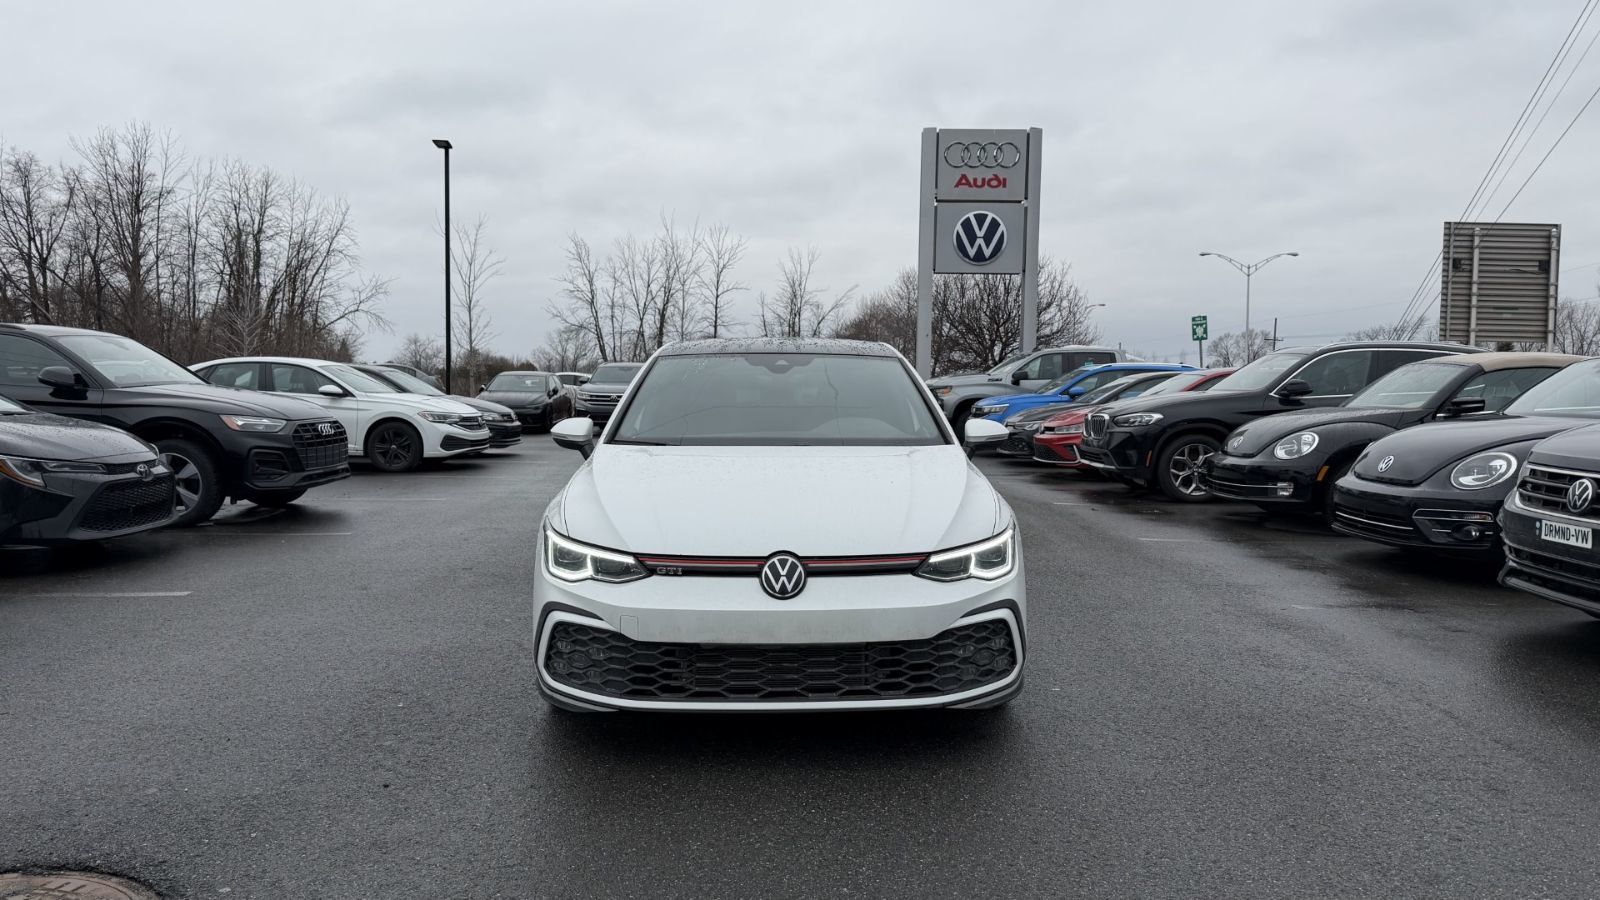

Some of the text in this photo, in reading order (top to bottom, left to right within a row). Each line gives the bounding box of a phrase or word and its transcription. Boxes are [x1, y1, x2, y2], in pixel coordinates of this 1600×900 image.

[954, 174, 1007, 188] Audi
[954, 211, 1006, 264] VW
[1567, 479, 1592, 512] VW
[1544, 522, 1590, 545] DRMND-VW
[656, 566, 683, 575] GTI
[763, 556, 804, 596] VW
